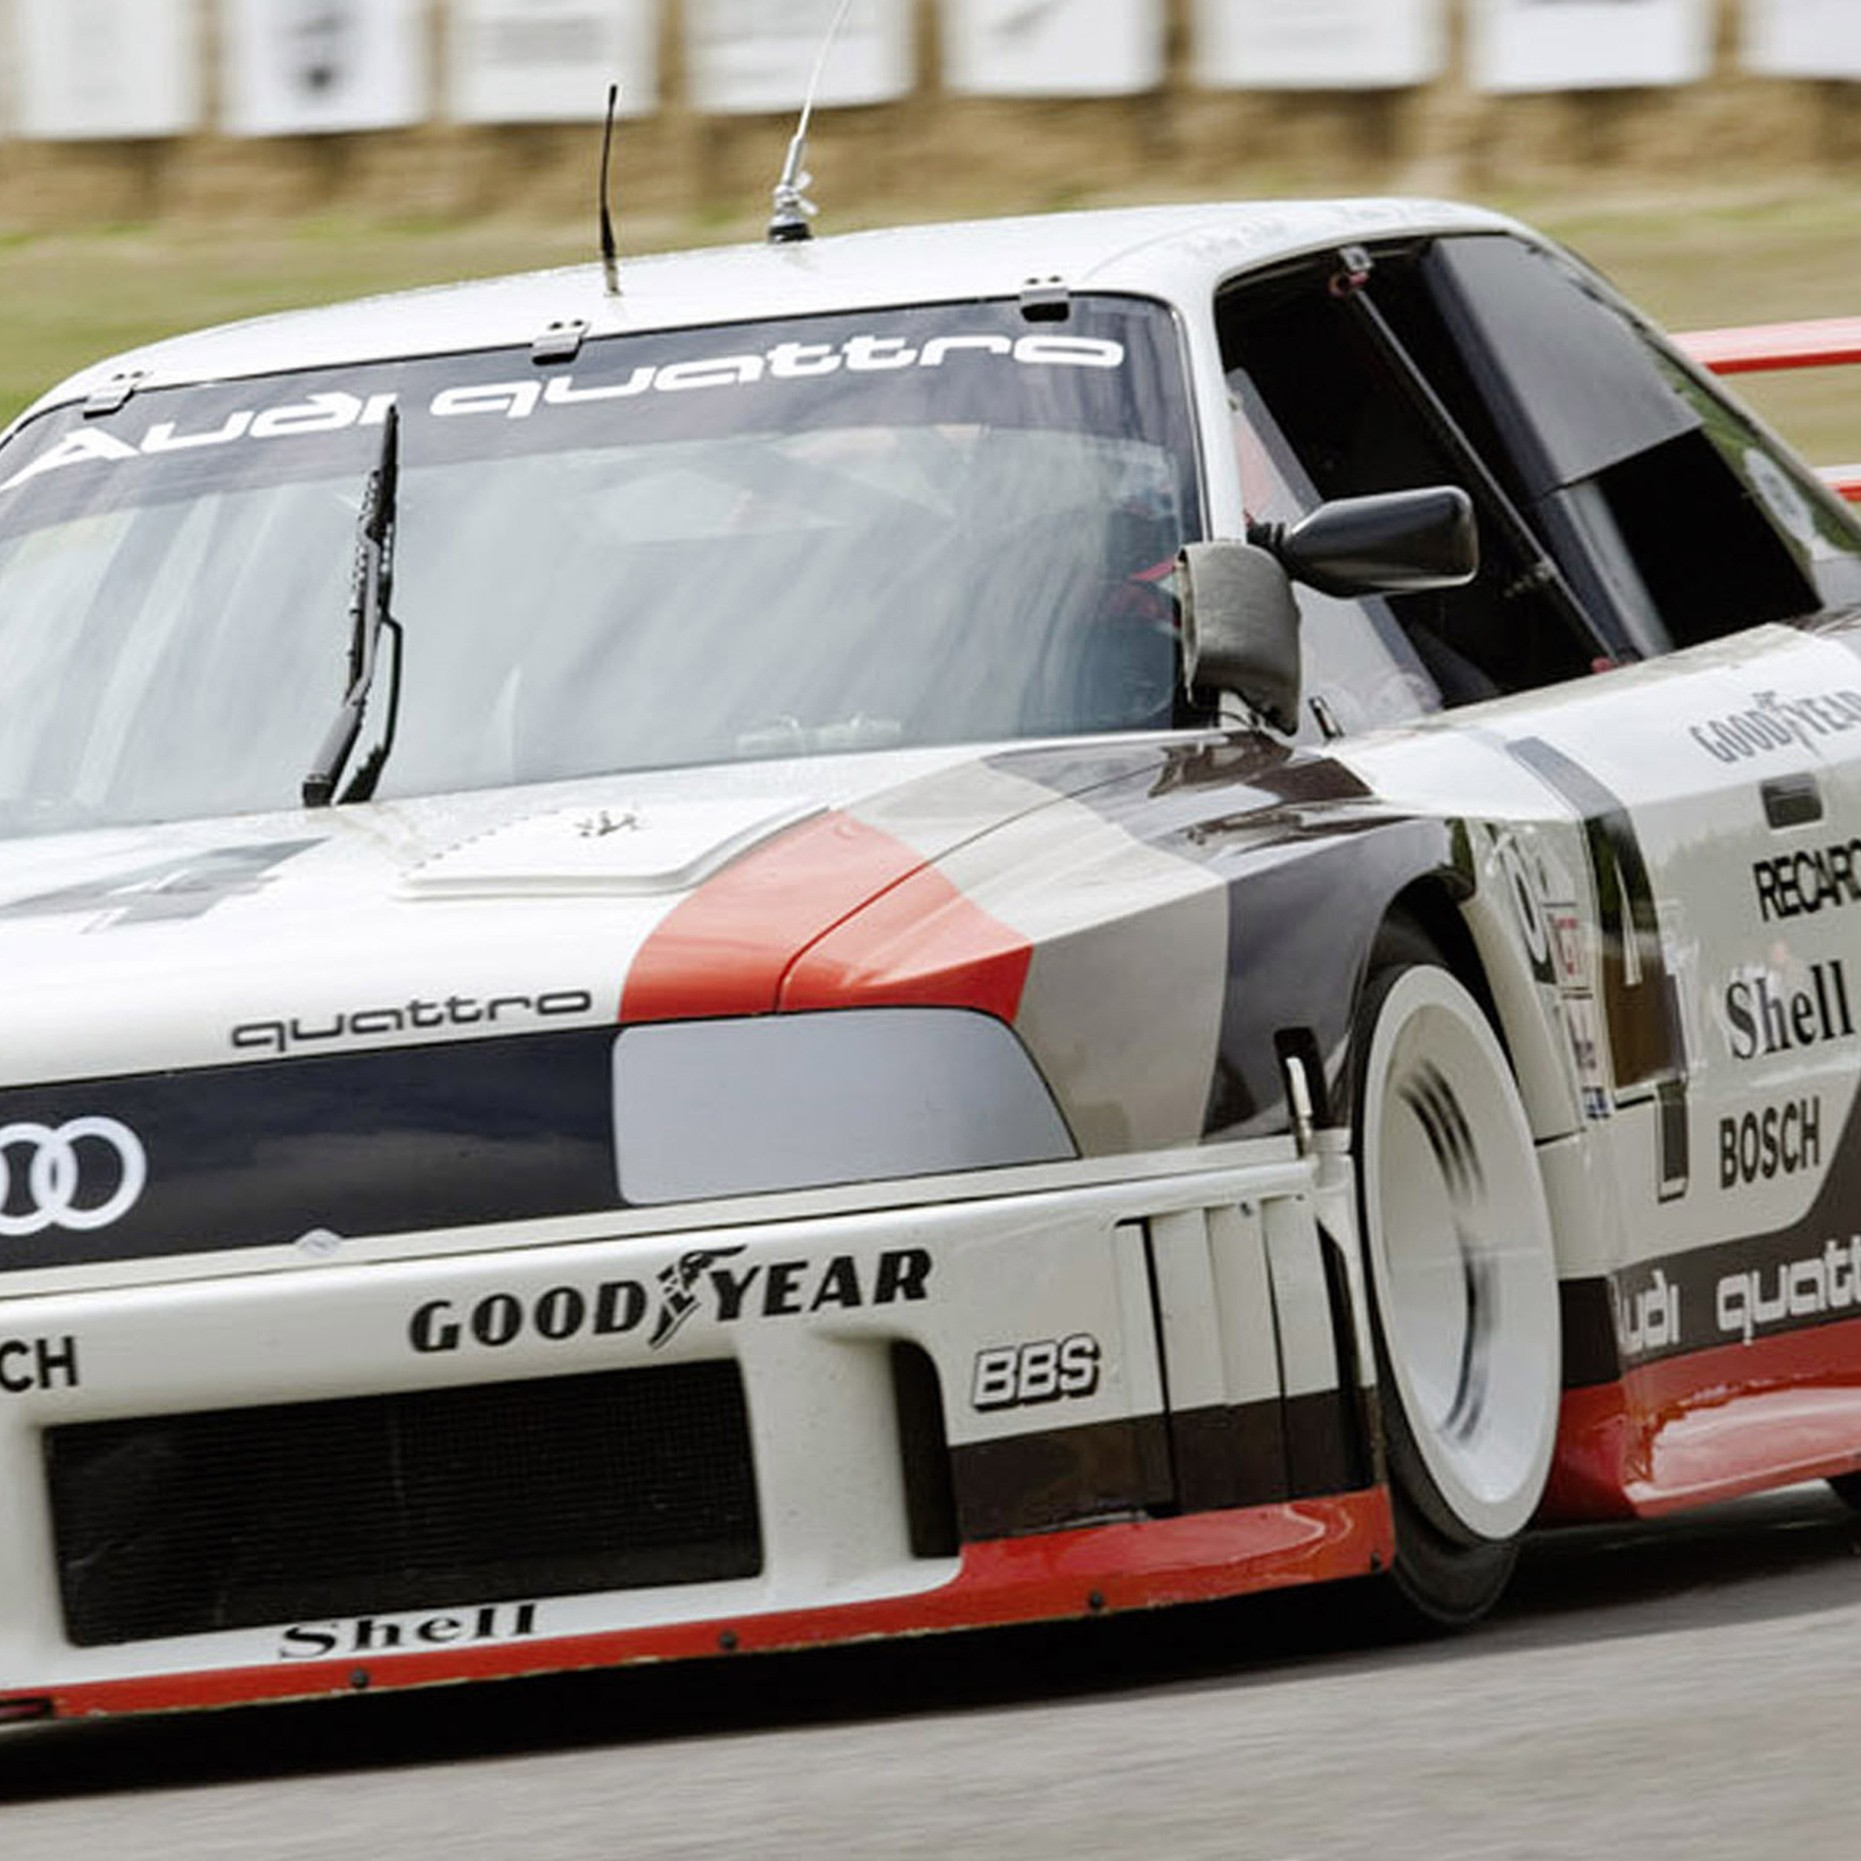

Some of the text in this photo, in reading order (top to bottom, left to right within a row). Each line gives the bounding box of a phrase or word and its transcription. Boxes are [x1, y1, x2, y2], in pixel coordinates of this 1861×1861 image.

[0, 334, 1125, 489] Audi quattro
[231, 990, 592, 1052] quattro
[1726, 960, 1855, 1060] Shell
[1720, 1096, 1819, 1189] BOSCH
[972, 1334, 1101, 1412] BBS
[280, 1603, 535, 1659] Shell
